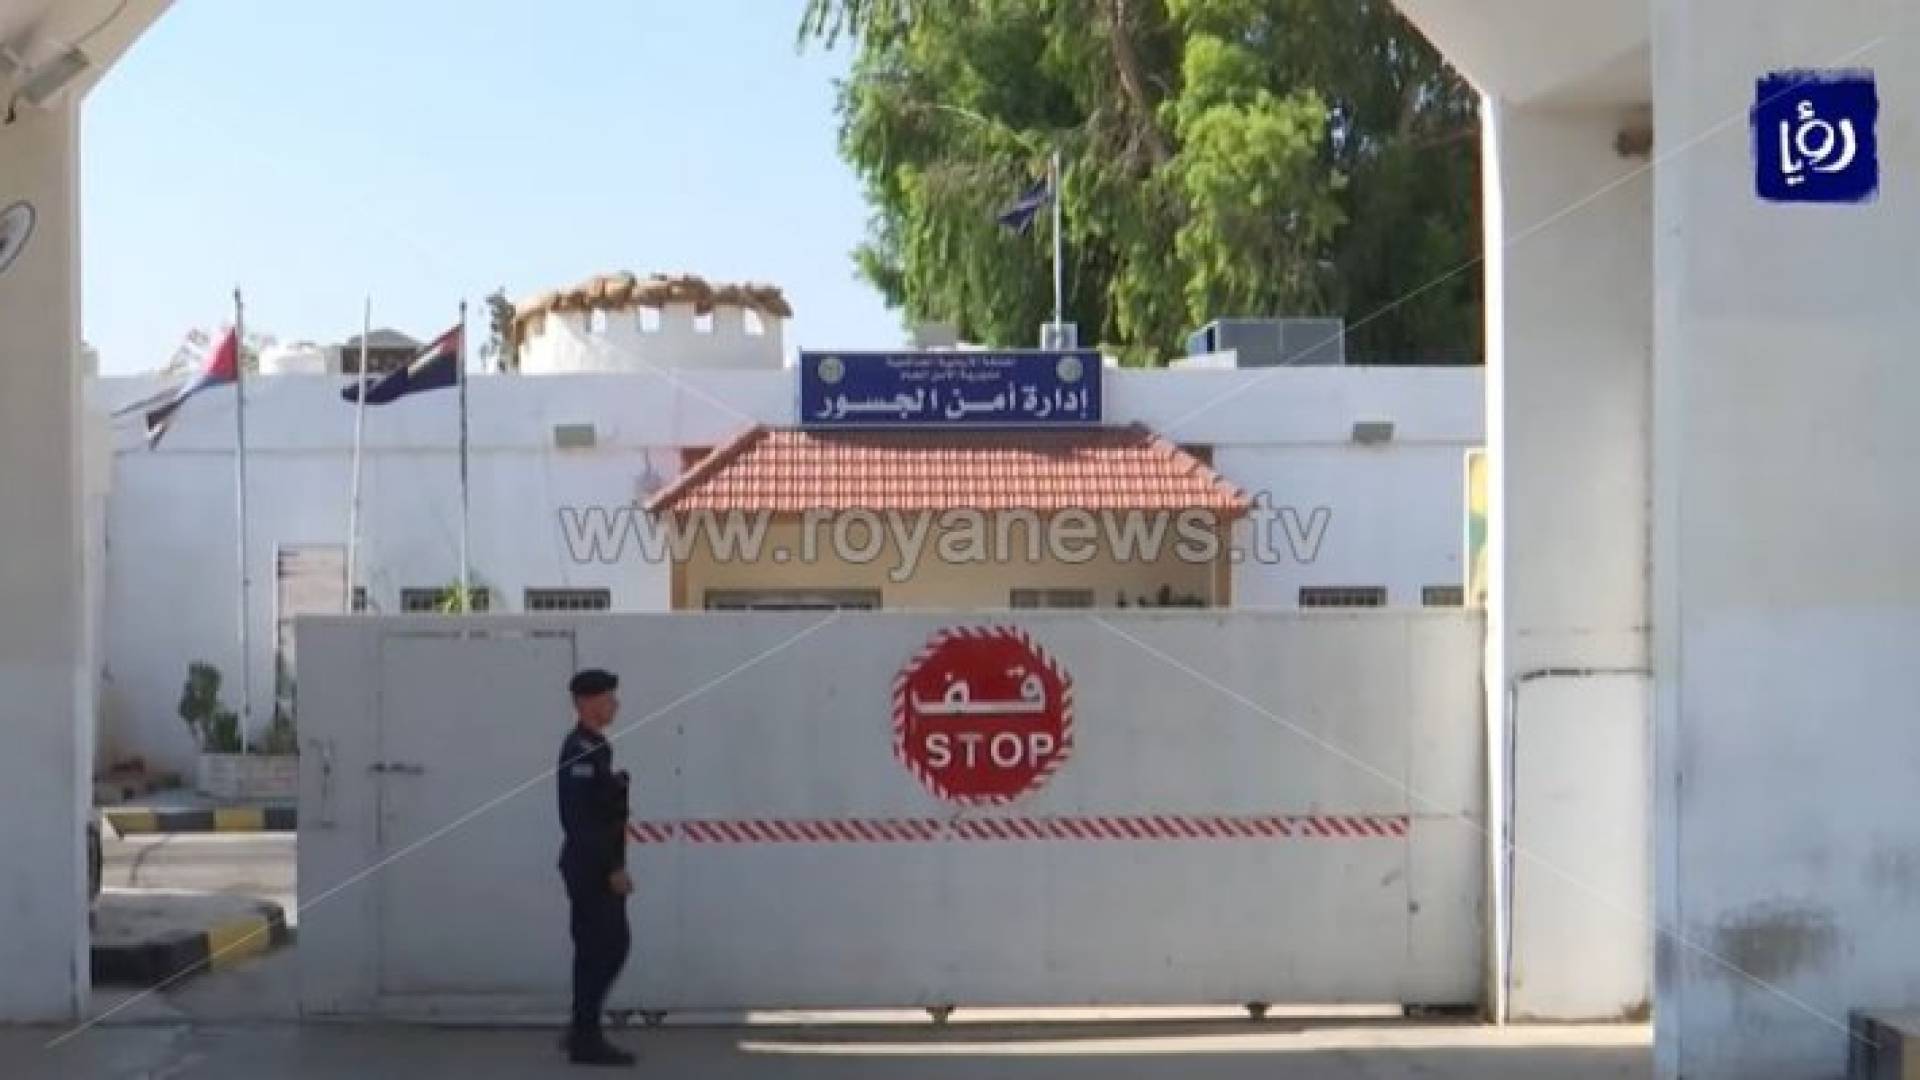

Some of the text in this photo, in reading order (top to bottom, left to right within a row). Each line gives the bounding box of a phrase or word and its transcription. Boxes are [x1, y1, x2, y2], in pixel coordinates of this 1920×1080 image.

[816, 387, 938, 420] الجسور
[1022, 384, 1088, 419] إدارة
[911, 664, 1046, 714] قف
[925, 731, 1055, 768] STOP
